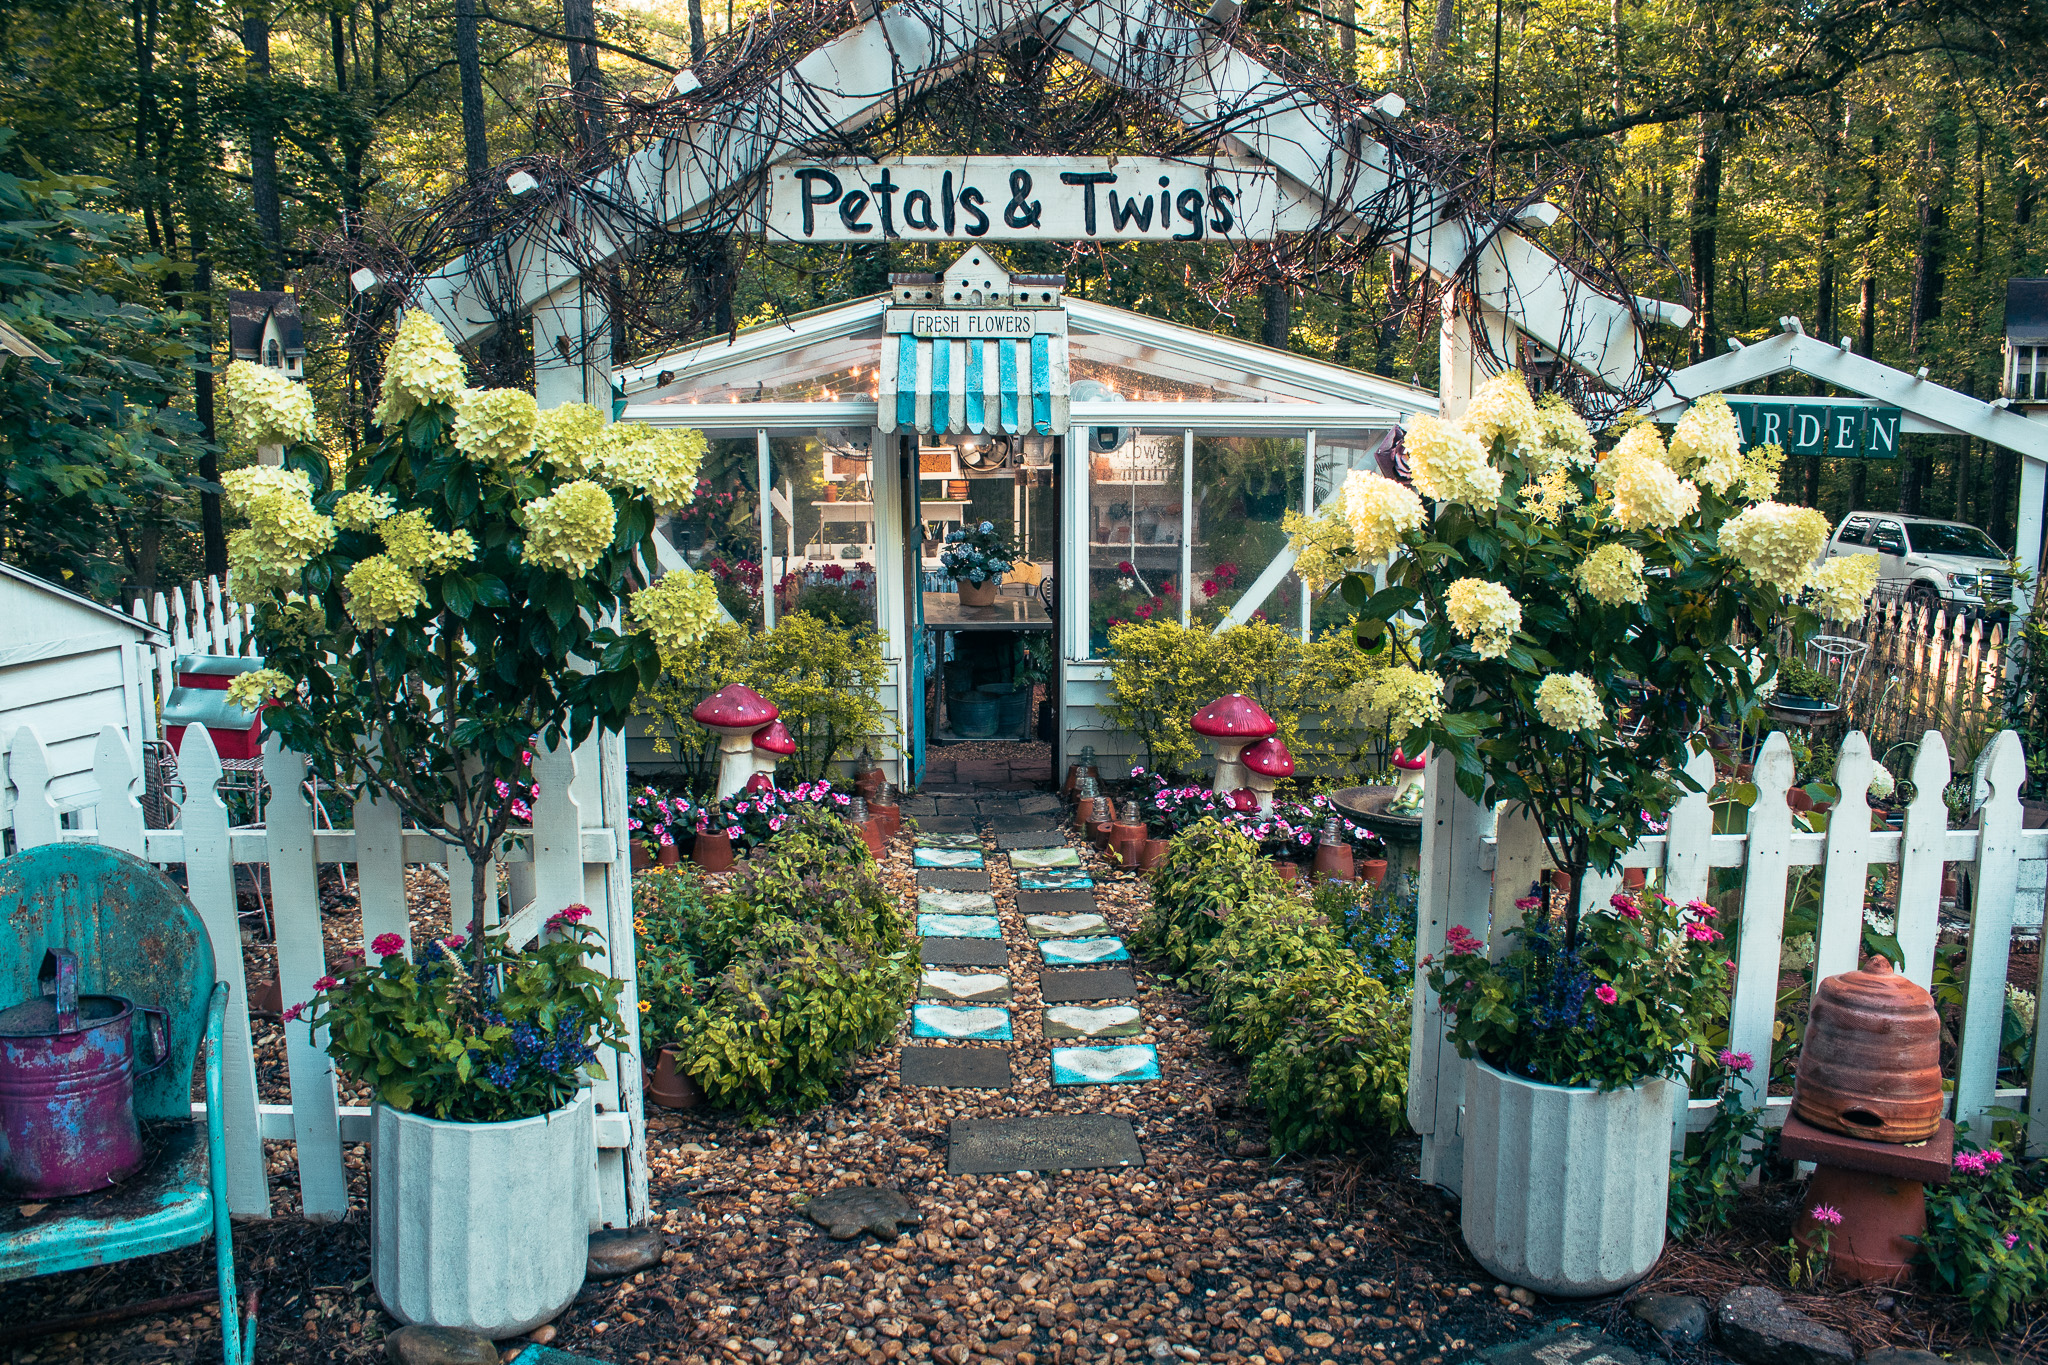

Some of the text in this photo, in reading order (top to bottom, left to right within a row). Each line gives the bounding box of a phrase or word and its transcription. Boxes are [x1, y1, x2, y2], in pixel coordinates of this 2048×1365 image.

[795, 168, 1234, 241] Petals & Twigs
[917, 316, 1031, 332] FRESH FLOWERS
[1735, 411, 1898, 452] ARDEN
[1116, 445, 1168, 459] FLOWE
